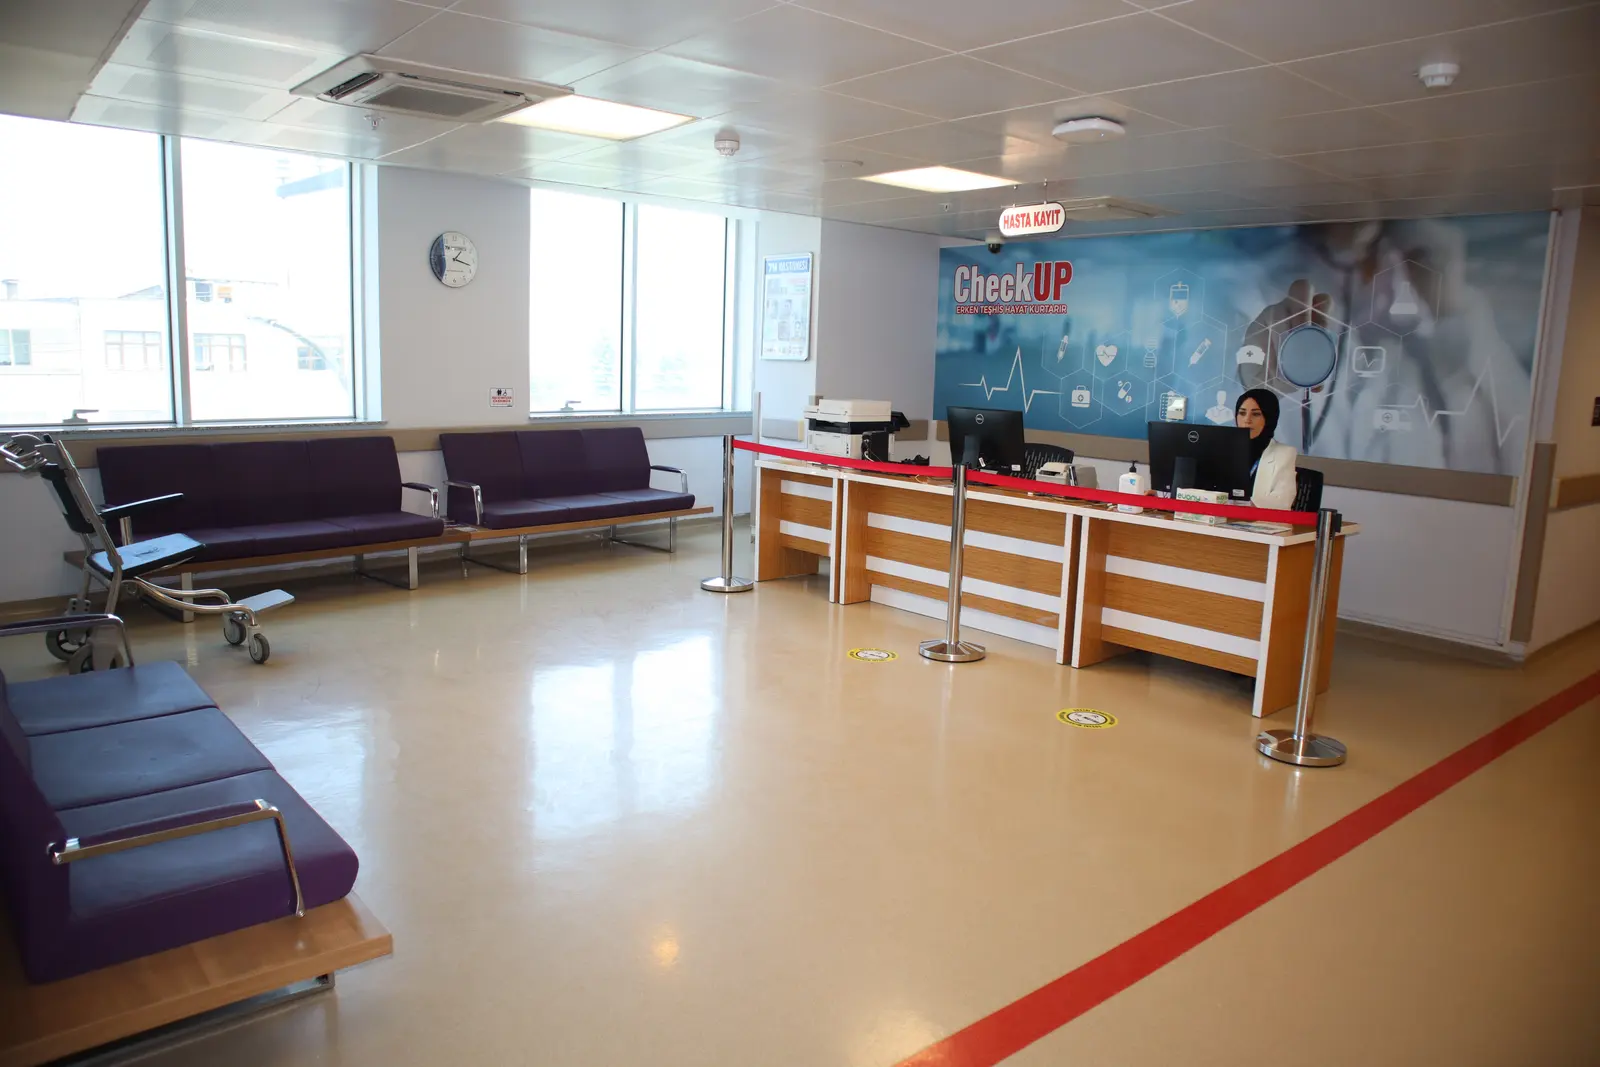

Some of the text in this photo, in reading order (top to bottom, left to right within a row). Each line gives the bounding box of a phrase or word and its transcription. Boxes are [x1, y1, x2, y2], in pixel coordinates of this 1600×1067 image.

[1003, 209, 1061, 229] HASTA KAYIT
[954, 261, 1073, 304] CheckUP
[956, 303, 1068, 317] ERKEN TEŞHİS HAYAT KURTARIR
